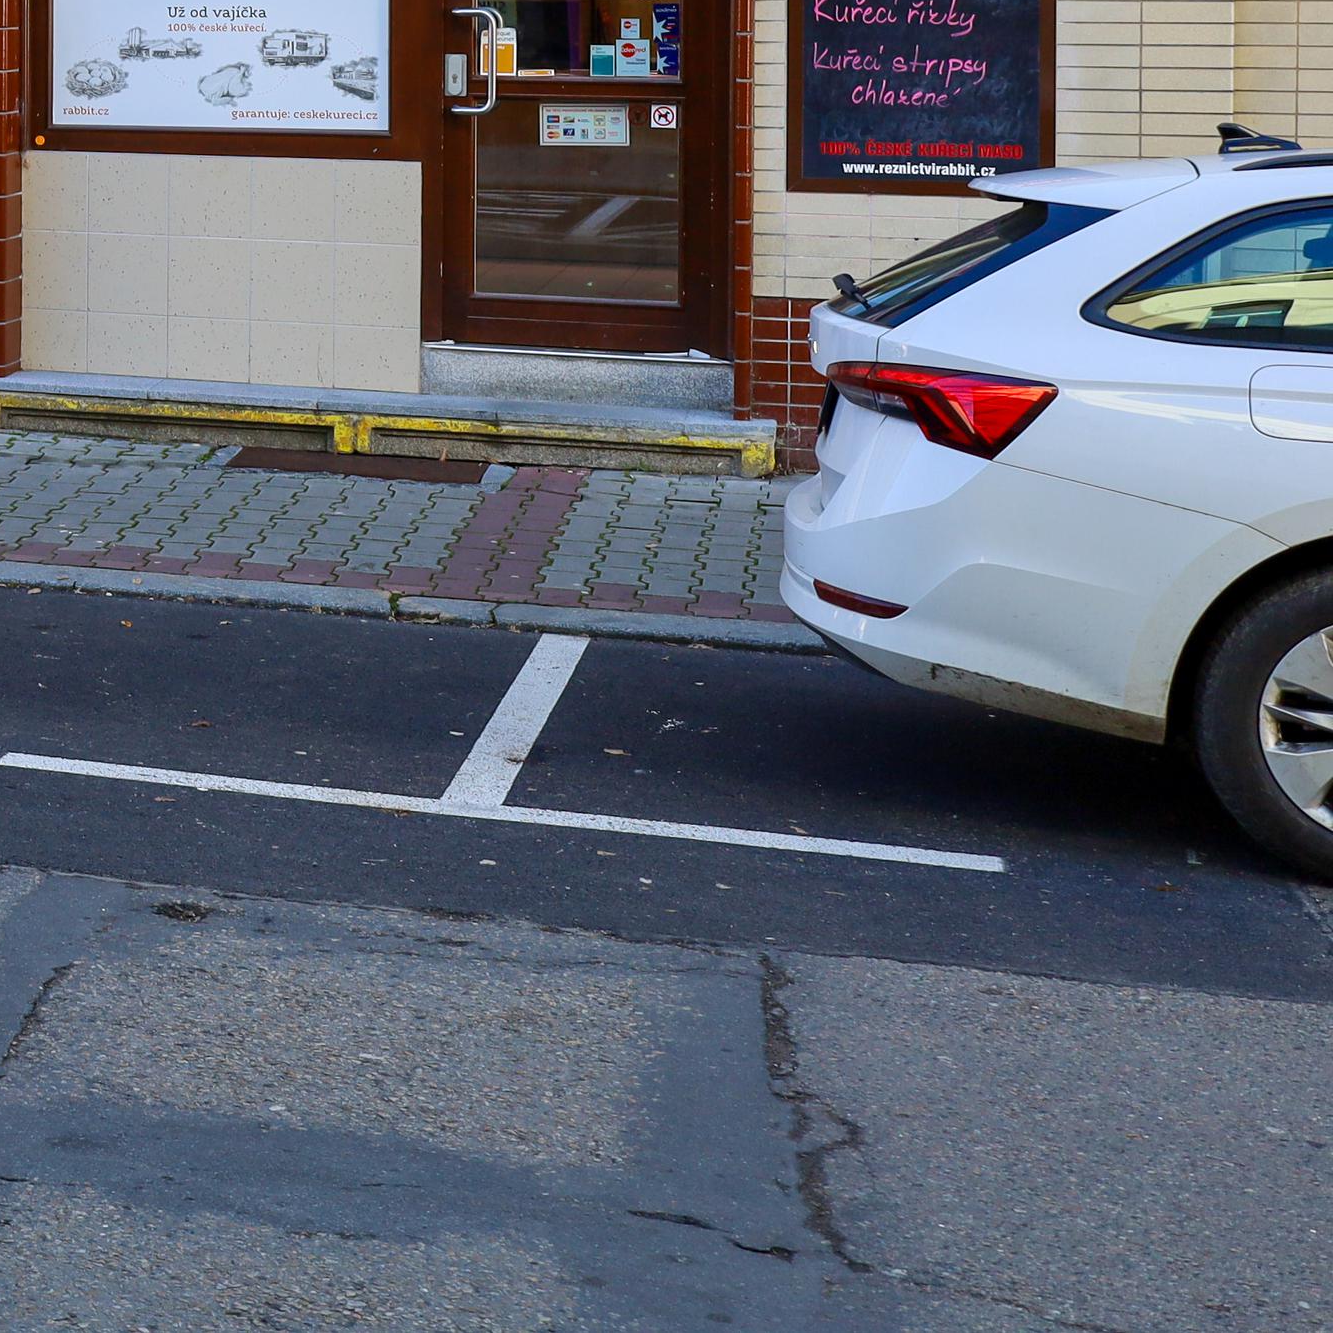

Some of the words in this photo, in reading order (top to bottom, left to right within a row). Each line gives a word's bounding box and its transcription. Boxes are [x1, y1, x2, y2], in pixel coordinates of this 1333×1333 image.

[167, 5, 186, 19] Už
[190, 6, 209, 19] od
[213, 5, 267, 21] vajíčka
[167, 23, 197, 33] 100%
[198, 22, 228, 33] české
[813, 43, 885, 71] Kuřecí
[892, 45, 988, 87] stripsy
[852, 79, 961, 108] chlazené
[62, 105, 110, 117] rabbit.cz
[231, 109, 291, 122] garantuje:
[293, 109, 378, 121] ceskekureci.cz
[820, 141, 860, 156] 100%
[866, 139, 911, 157] ČESKÉ
[917, 140, 973, 158] KUŘECÍ
[979, 144, 1023, 159] MASO
[843, 162, 996, 177] www.reznictvirabbit.cz
